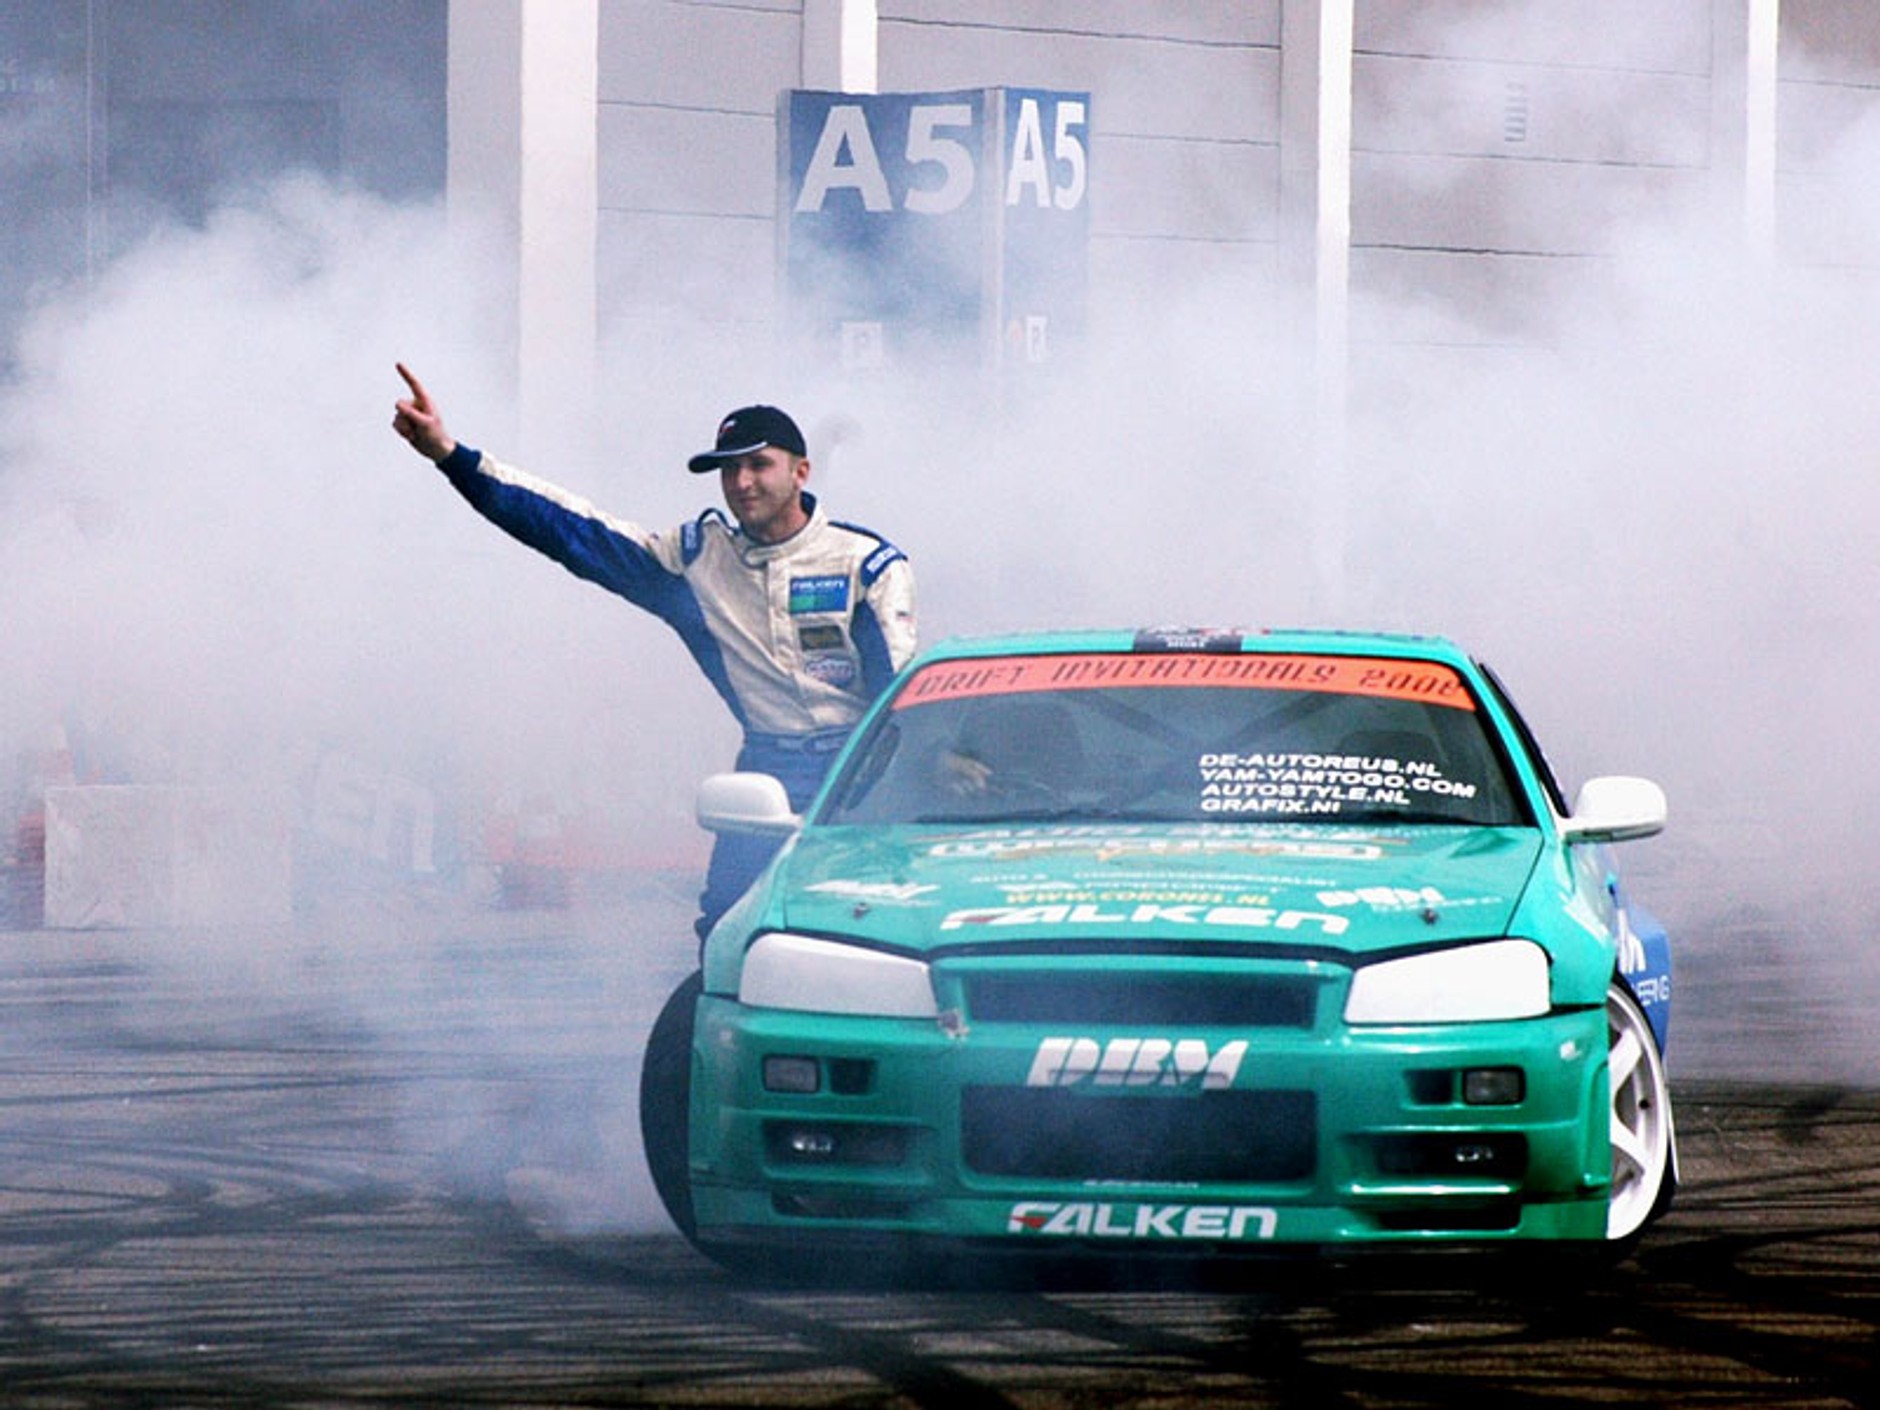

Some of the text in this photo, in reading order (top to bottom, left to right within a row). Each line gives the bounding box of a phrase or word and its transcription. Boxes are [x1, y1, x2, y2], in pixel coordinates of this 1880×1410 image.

[794, 105, 975, 214] A5
[1006, 99, 1086, 210] A5
[916, 665, 1032, 697] DRIFT
[1052, 658, 1336, 684] INVITATIONALS
[1202, 783, 1410, 804] AUTOSTYLE.NL
[940, 905, 1349, 934] FALKEN
[1008, 1201, 1277, 1238] FALKEN
